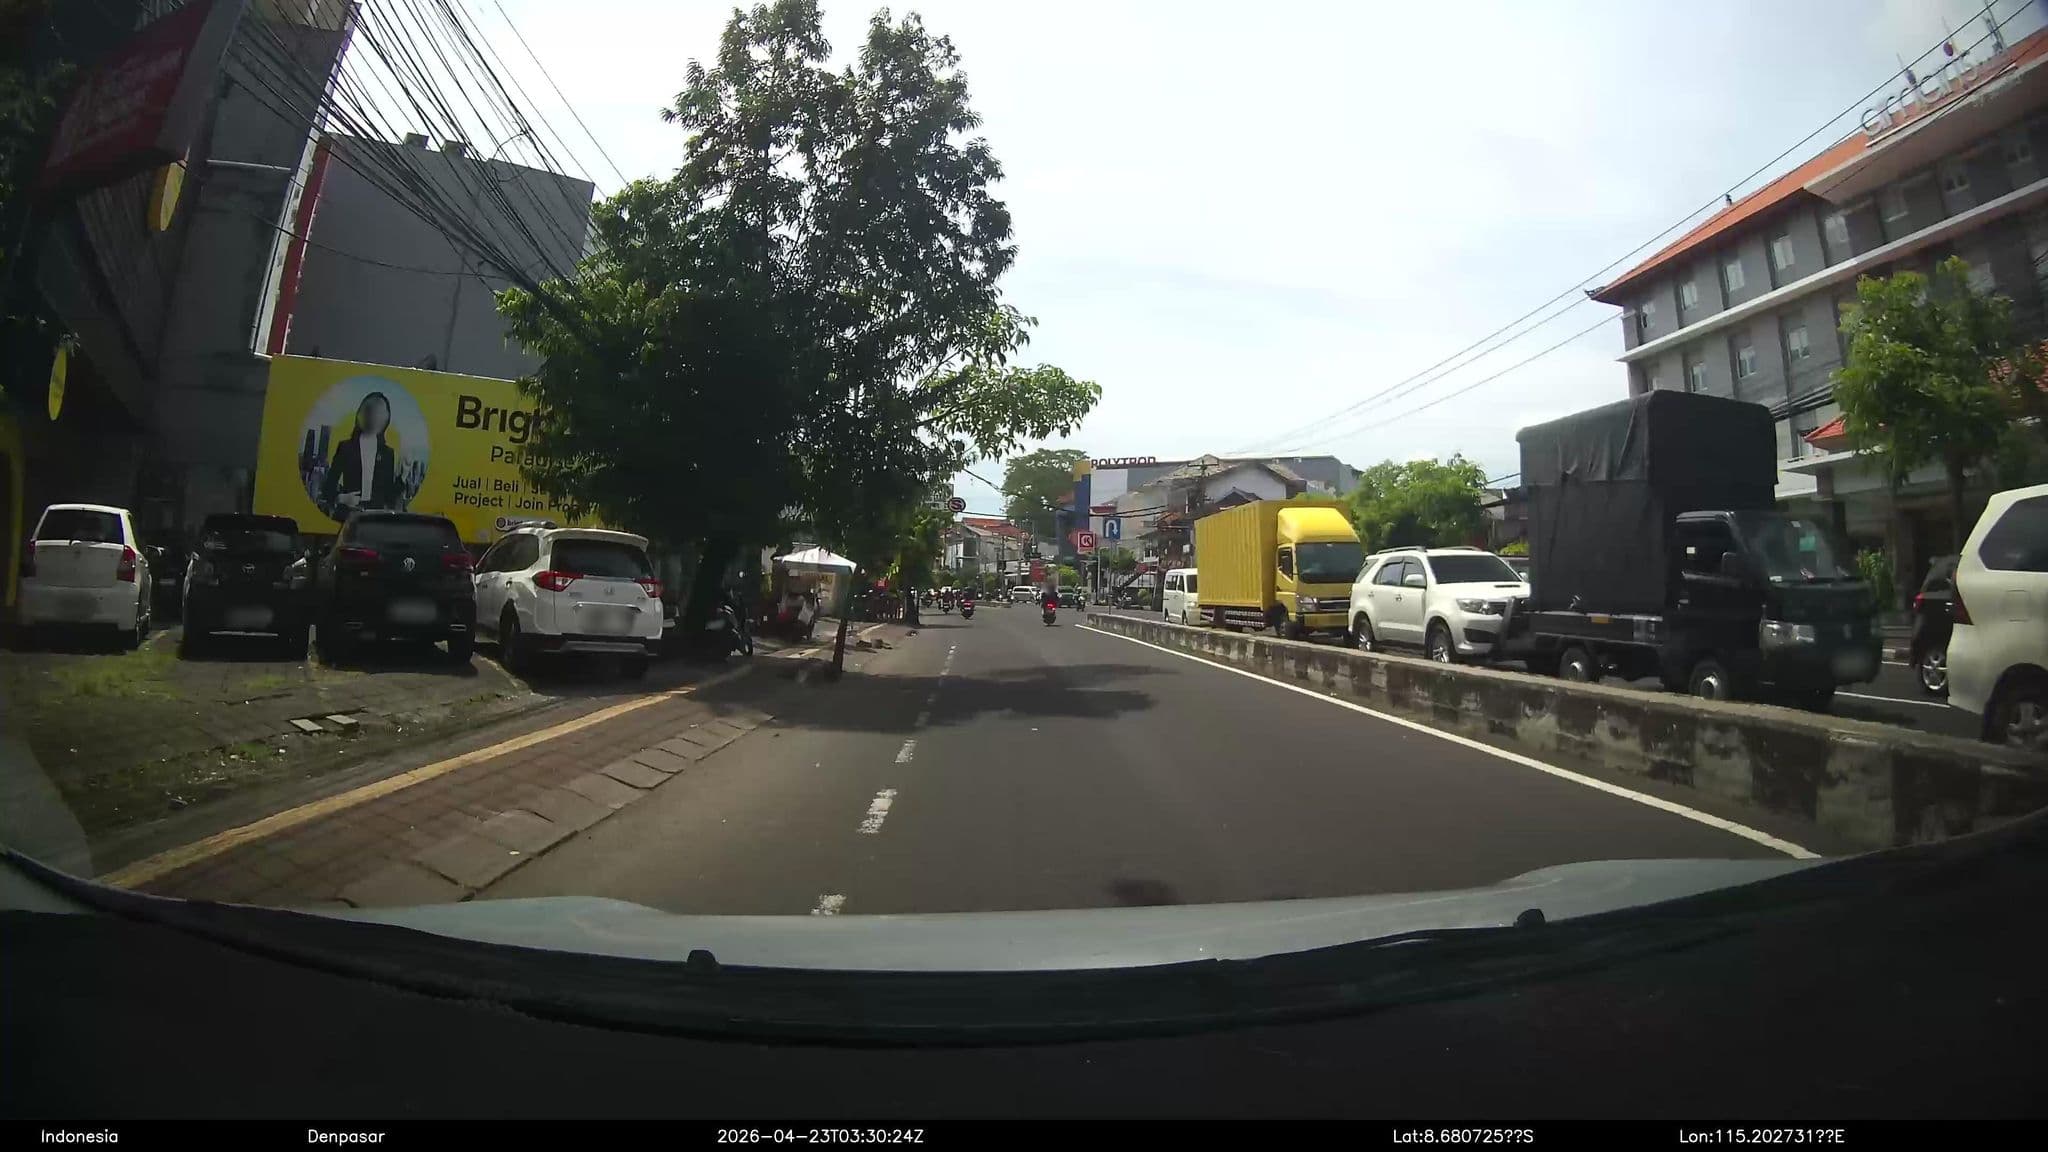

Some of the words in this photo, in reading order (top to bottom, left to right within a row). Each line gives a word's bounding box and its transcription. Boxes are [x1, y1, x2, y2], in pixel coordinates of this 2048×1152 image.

[453, 476, 481, 489] Jual
[494, 480, 519, 492] Beli
[454, 492, 503, 509] Project
[515, 497, 544, 511] Join
